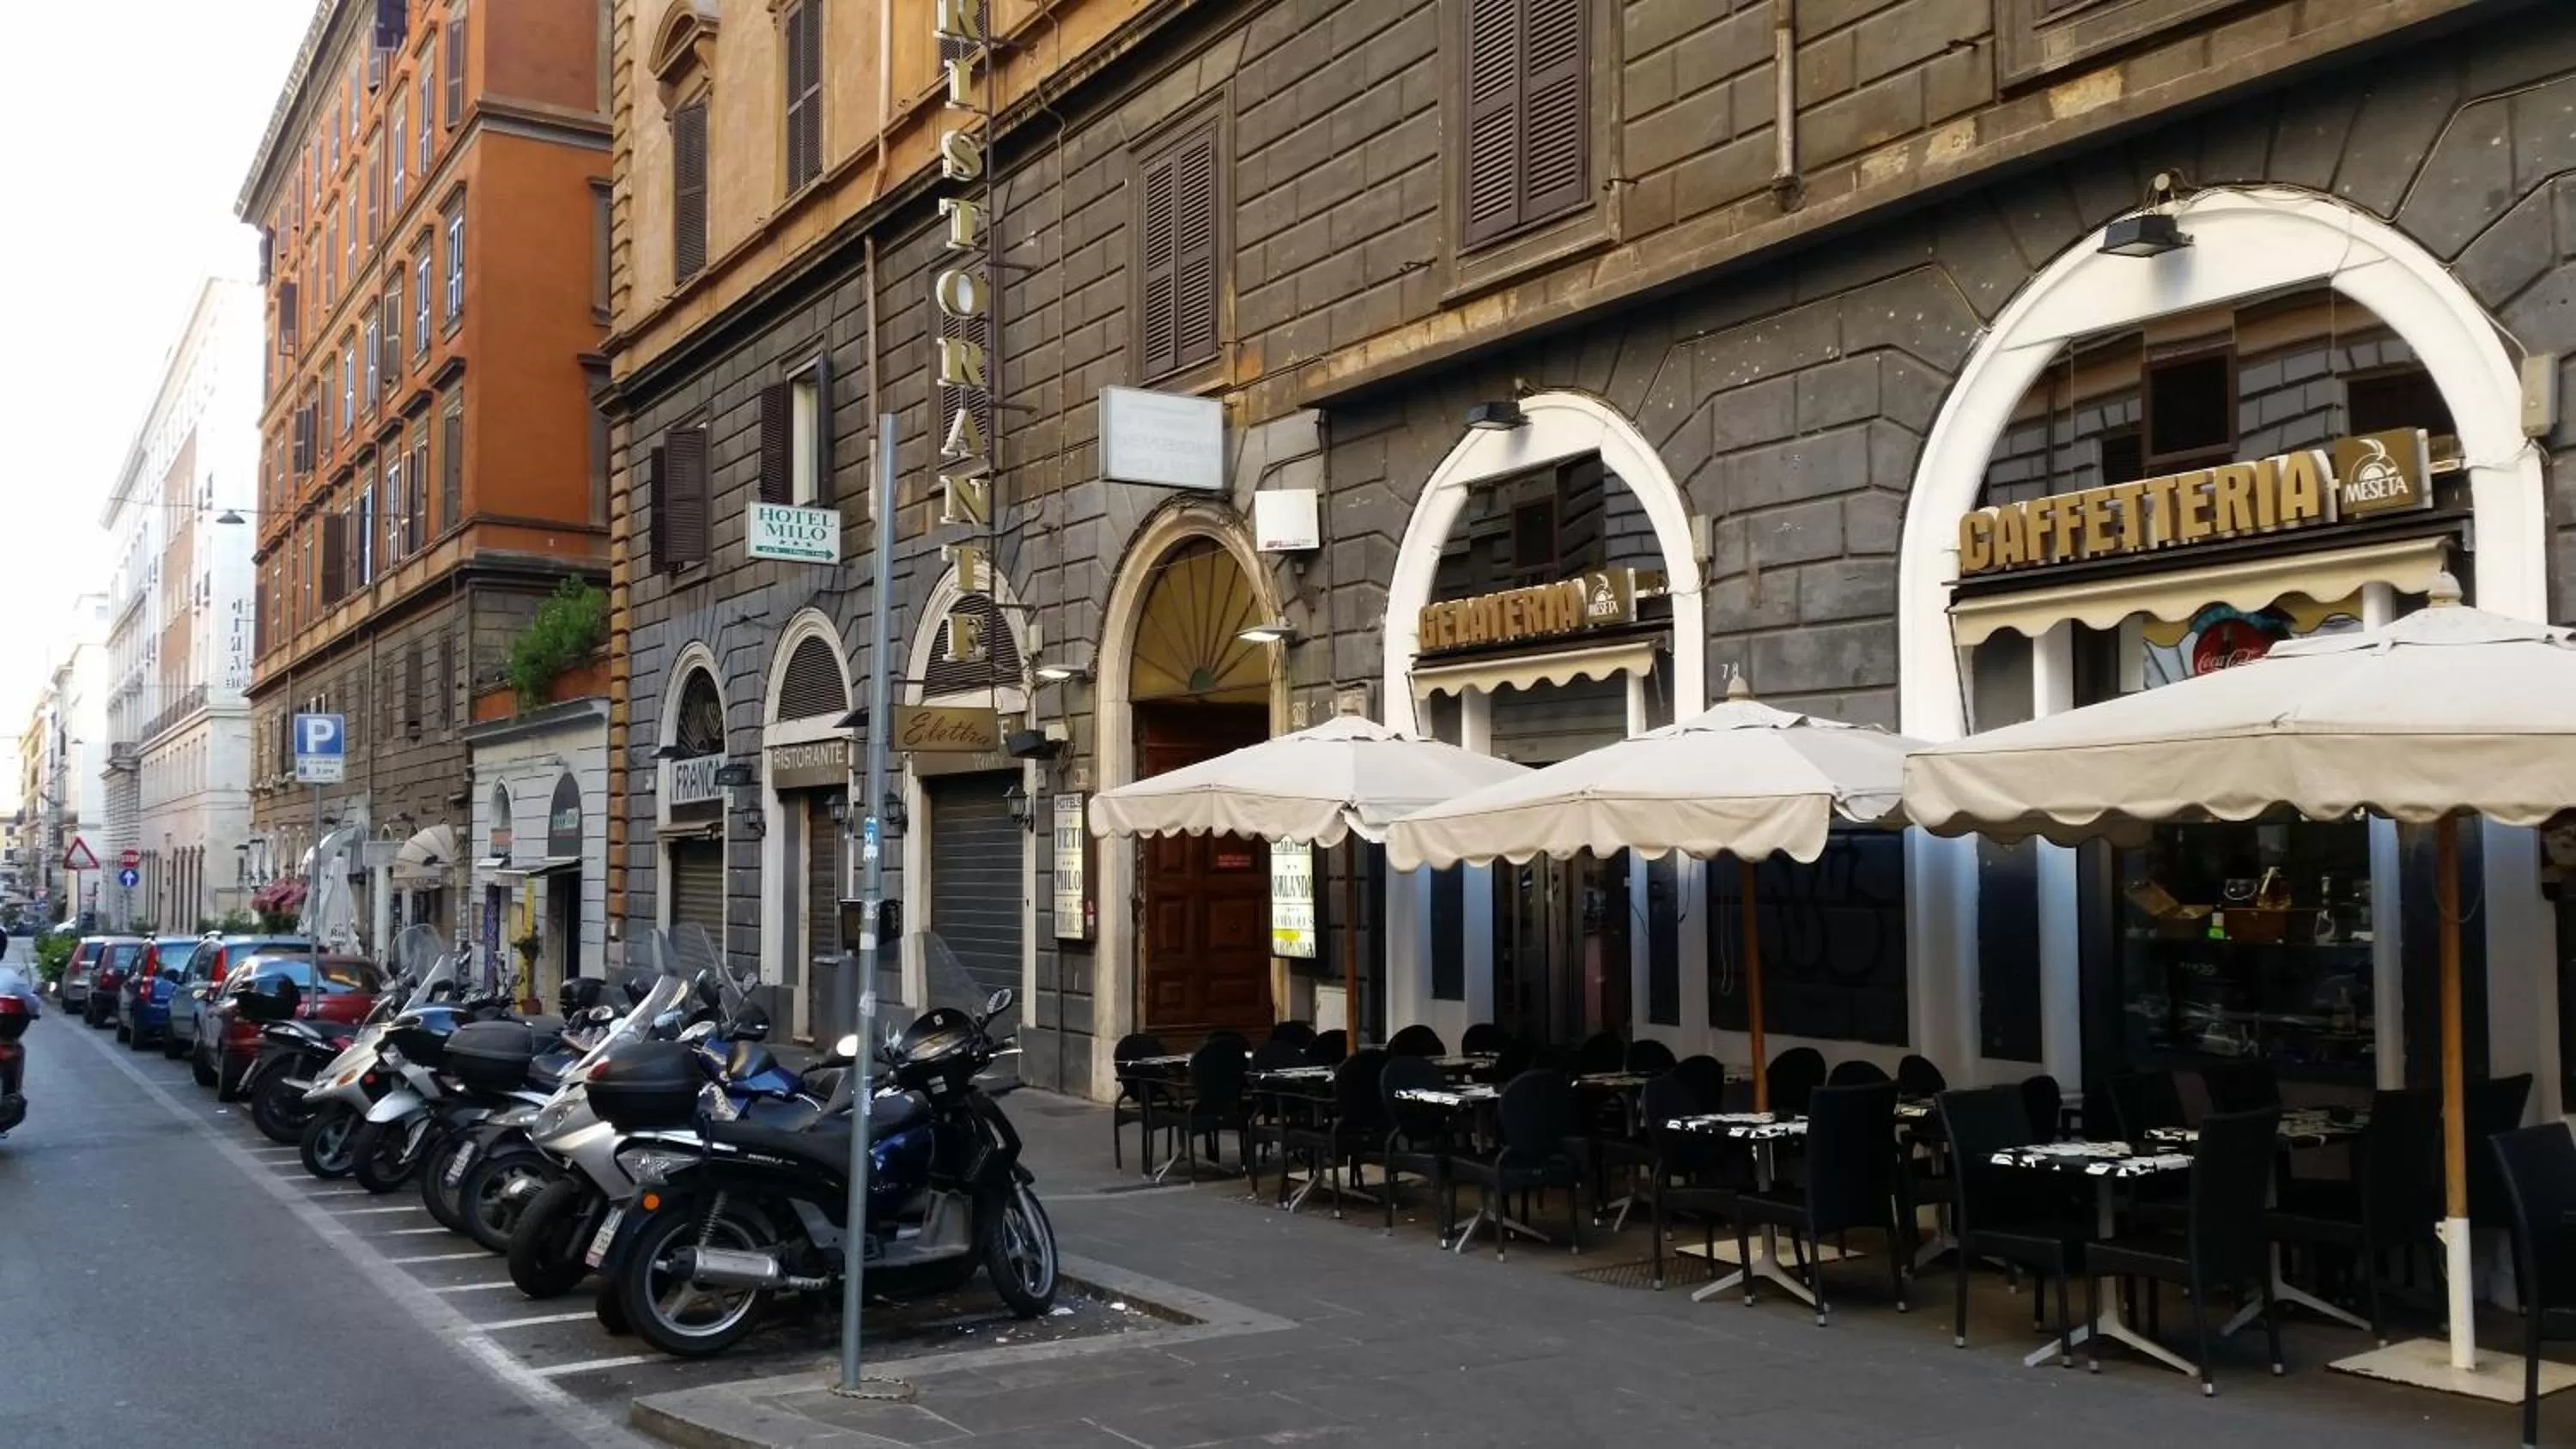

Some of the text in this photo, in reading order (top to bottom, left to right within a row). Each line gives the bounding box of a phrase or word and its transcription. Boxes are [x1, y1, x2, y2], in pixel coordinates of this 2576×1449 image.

[2344, 475, 2409, 504] MESETA
[758, 507, 835, 528] HOTEL
[1959, 450, 2329, 573] CAFFETTERIA
[765, 523, 827, 542] MILO
[1419, 579, 1585, 651] GELATERIA
[307, 718, 335, 753] P
[903, 711, 991, 746] Elettra
[773, 741, 845, 770] RISTORANTE
[1055, 870, 1081, 891] MILO
